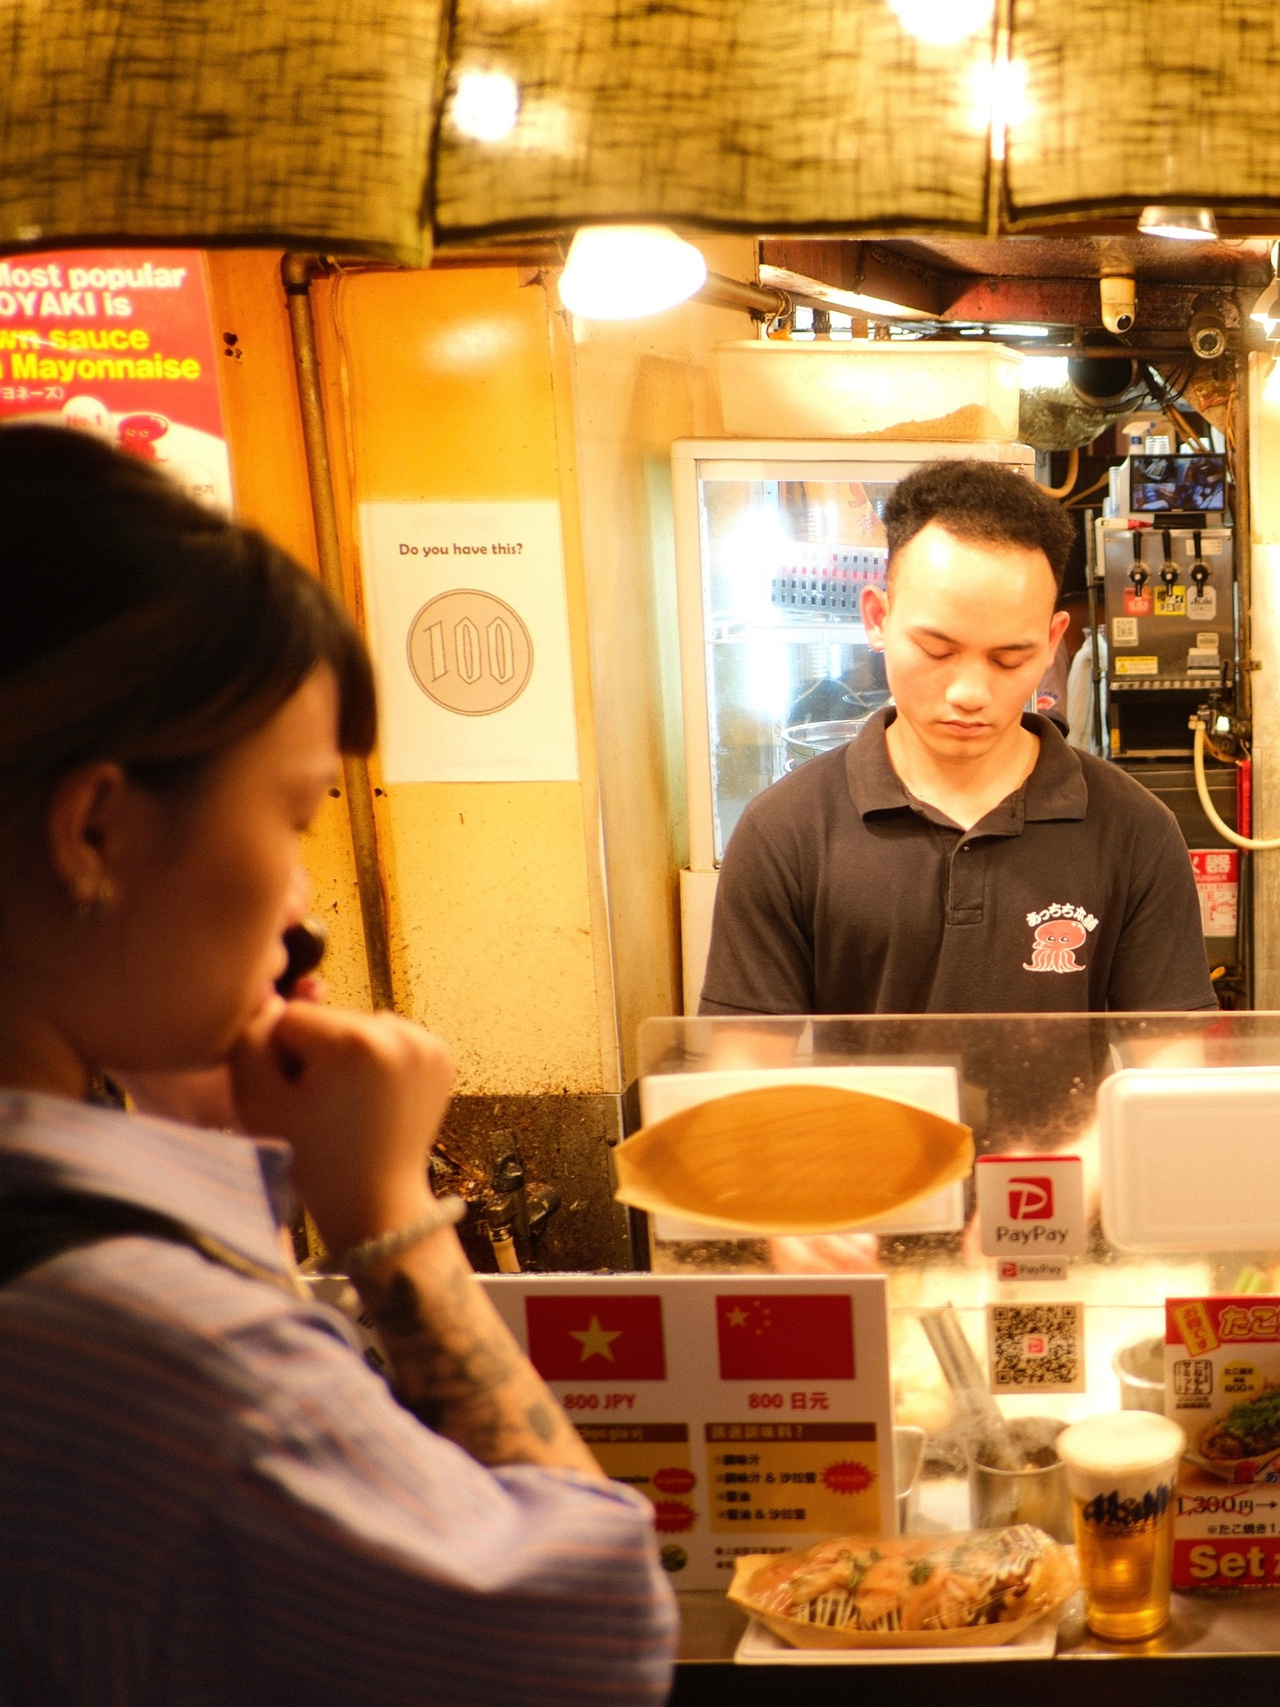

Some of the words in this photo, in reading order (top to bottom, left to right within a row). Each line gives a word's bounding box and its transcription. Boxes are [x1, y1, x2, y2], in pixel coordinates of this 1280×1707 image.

[68, 262, 186, 290] popular
[104, 293, 132, 316] is
[50, 328, 149, 349] sauce
[11, 353, 200, 382] Mayonnaise
[399, 543, 419, 556] Do
[422, 546, 449, 557] you
[453, 543, 487, 555] have
[492, 543, 523, 555] this?
[423, 616, 516, 685] 100
[996, 1226, 1069, 1244] PayPay
[1020, 1263, 1062, 1275] PayPay
[603, 1394, 636, 1410] JPY
[748, 1394, 782, 1409] 800
[1190, 1545, 1264, 1578] Set
